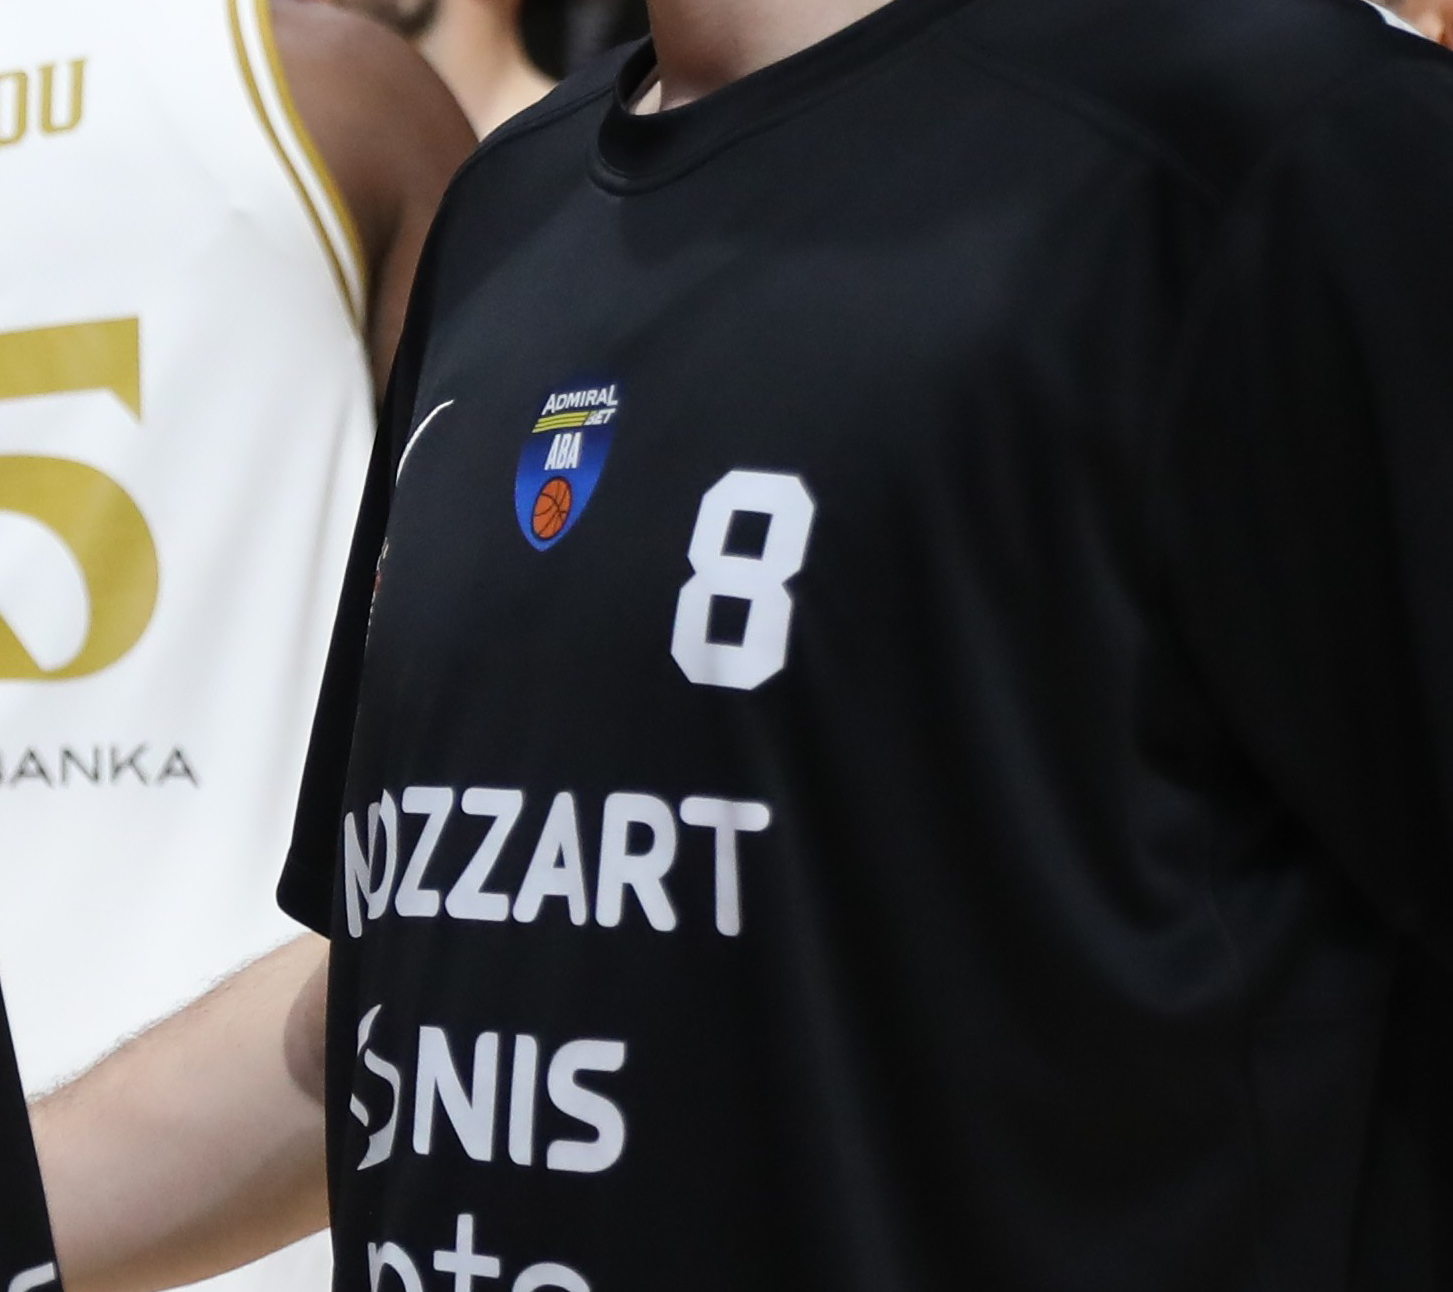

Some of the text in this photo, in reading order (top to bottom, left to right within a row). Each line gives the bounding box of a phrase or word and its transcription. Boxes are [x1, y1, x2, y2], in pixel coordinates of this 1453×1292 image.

[541, 384, 619, 416] ADMIRAL
[544, 431, 582, 471] ABA
[670, 469, 816, 691] 8
[413, 1025, 626, 1173] NIS
